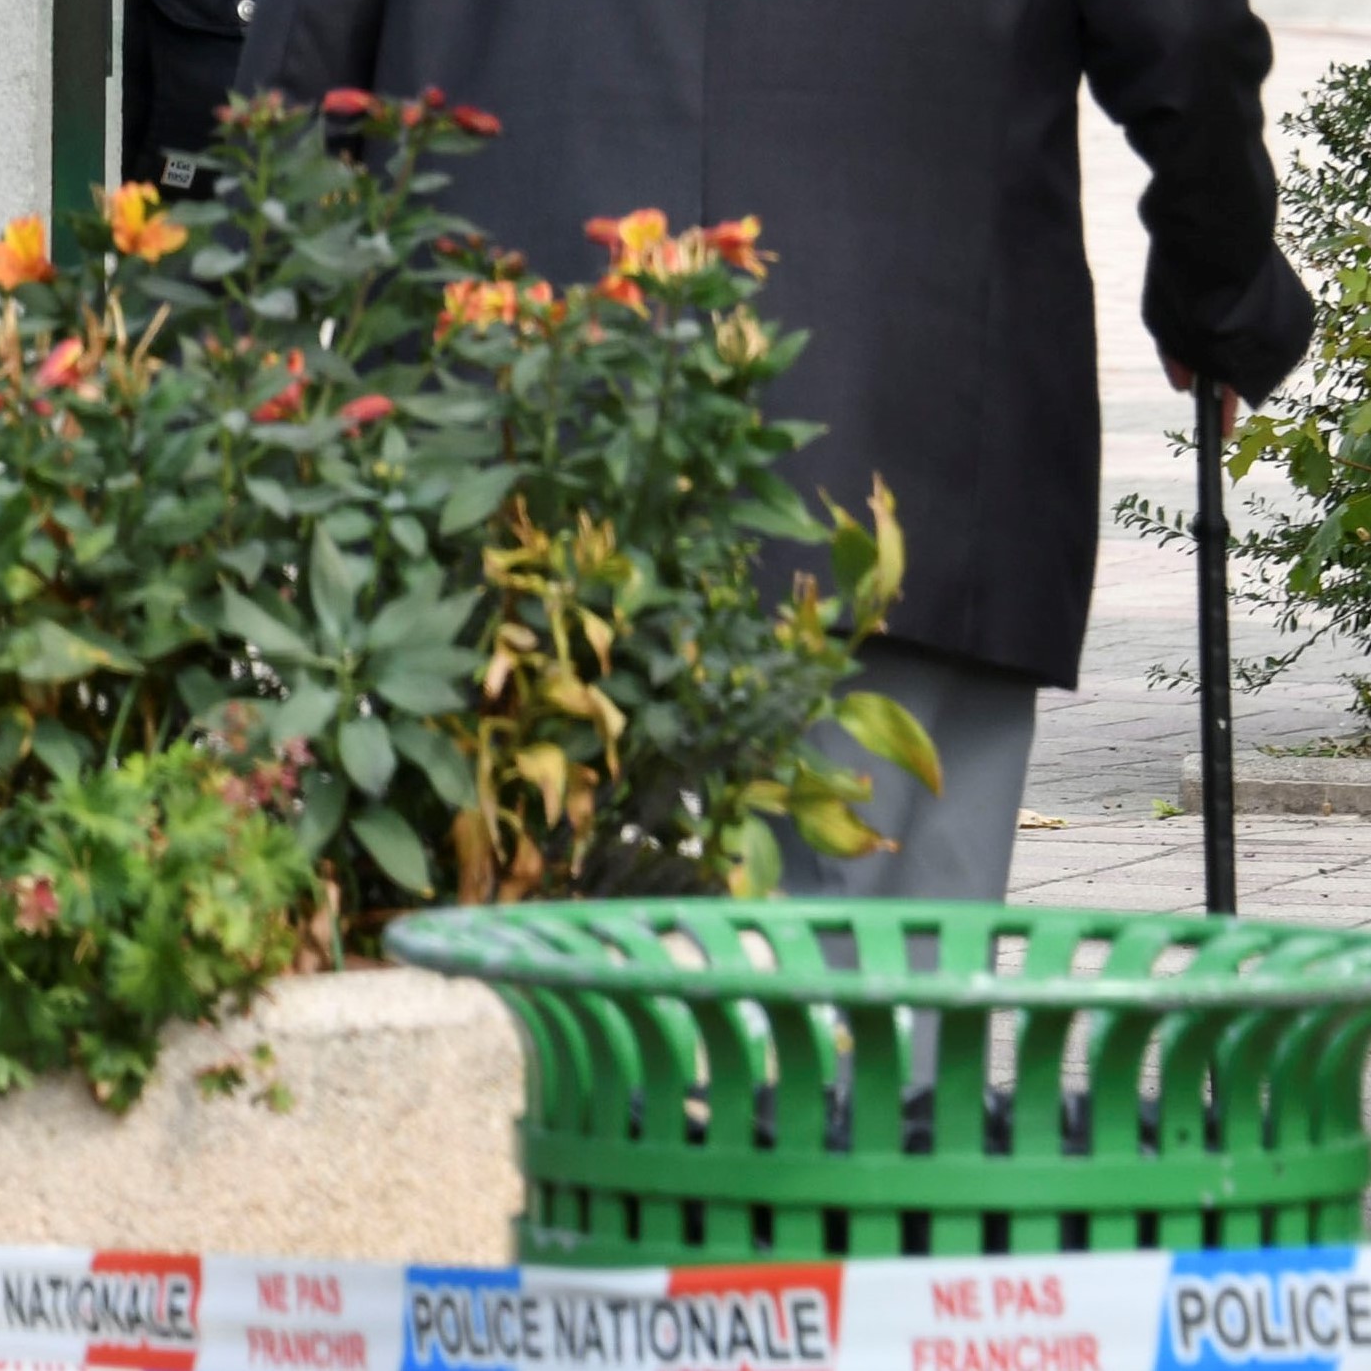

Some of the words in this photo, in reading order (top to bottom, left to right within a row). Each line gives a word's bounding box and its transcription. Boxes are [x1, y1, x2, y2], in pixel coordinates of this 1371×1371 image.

[3, 1272, 194, 1341] NATIONALE
[256, 1273, 288, 1314] NE
[295, 1274, 342, 1316] PAS
[931, 1278, 982, 1321] NE
[992, 1275, 1066, 1317] PAS
[1177, 1284, 1371, 1351] POLICE
[246, 1326, 367, 1370] FRANCHIR
[413, 1295, 544, 1360] POLICE
[554, 1296, 825, 1363] NATIONALE
[910, 1332, 1102, 1371] FRANCHIR
